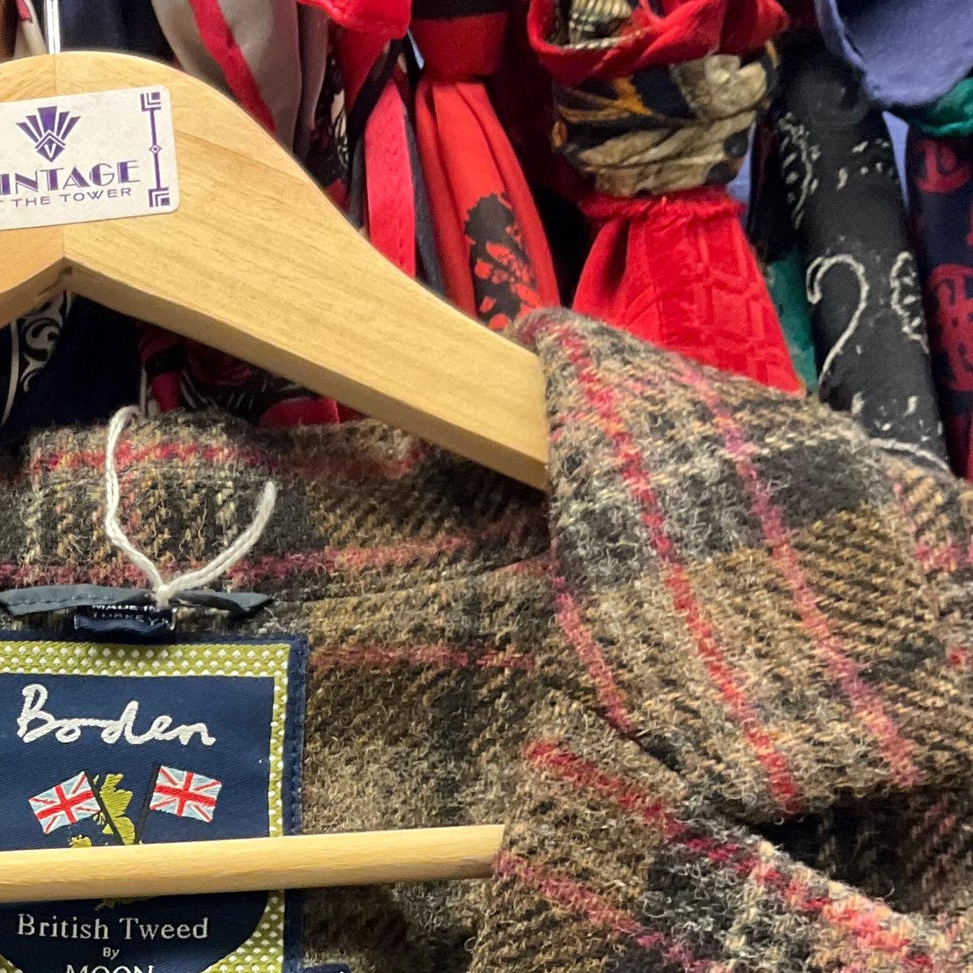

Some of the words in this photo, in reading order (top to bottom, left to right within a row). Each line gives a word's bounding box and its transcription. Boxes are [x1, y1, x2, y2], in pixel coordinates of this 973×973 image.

[11, 196, 51, 208] THE
[60, 187, 132, 203] TOWER
[16, 683, 217, 746] Boden
[16, 913, 110, 940] British
[119, 917, 209, 940] Tweed
[102, 946, 120, 960] By
